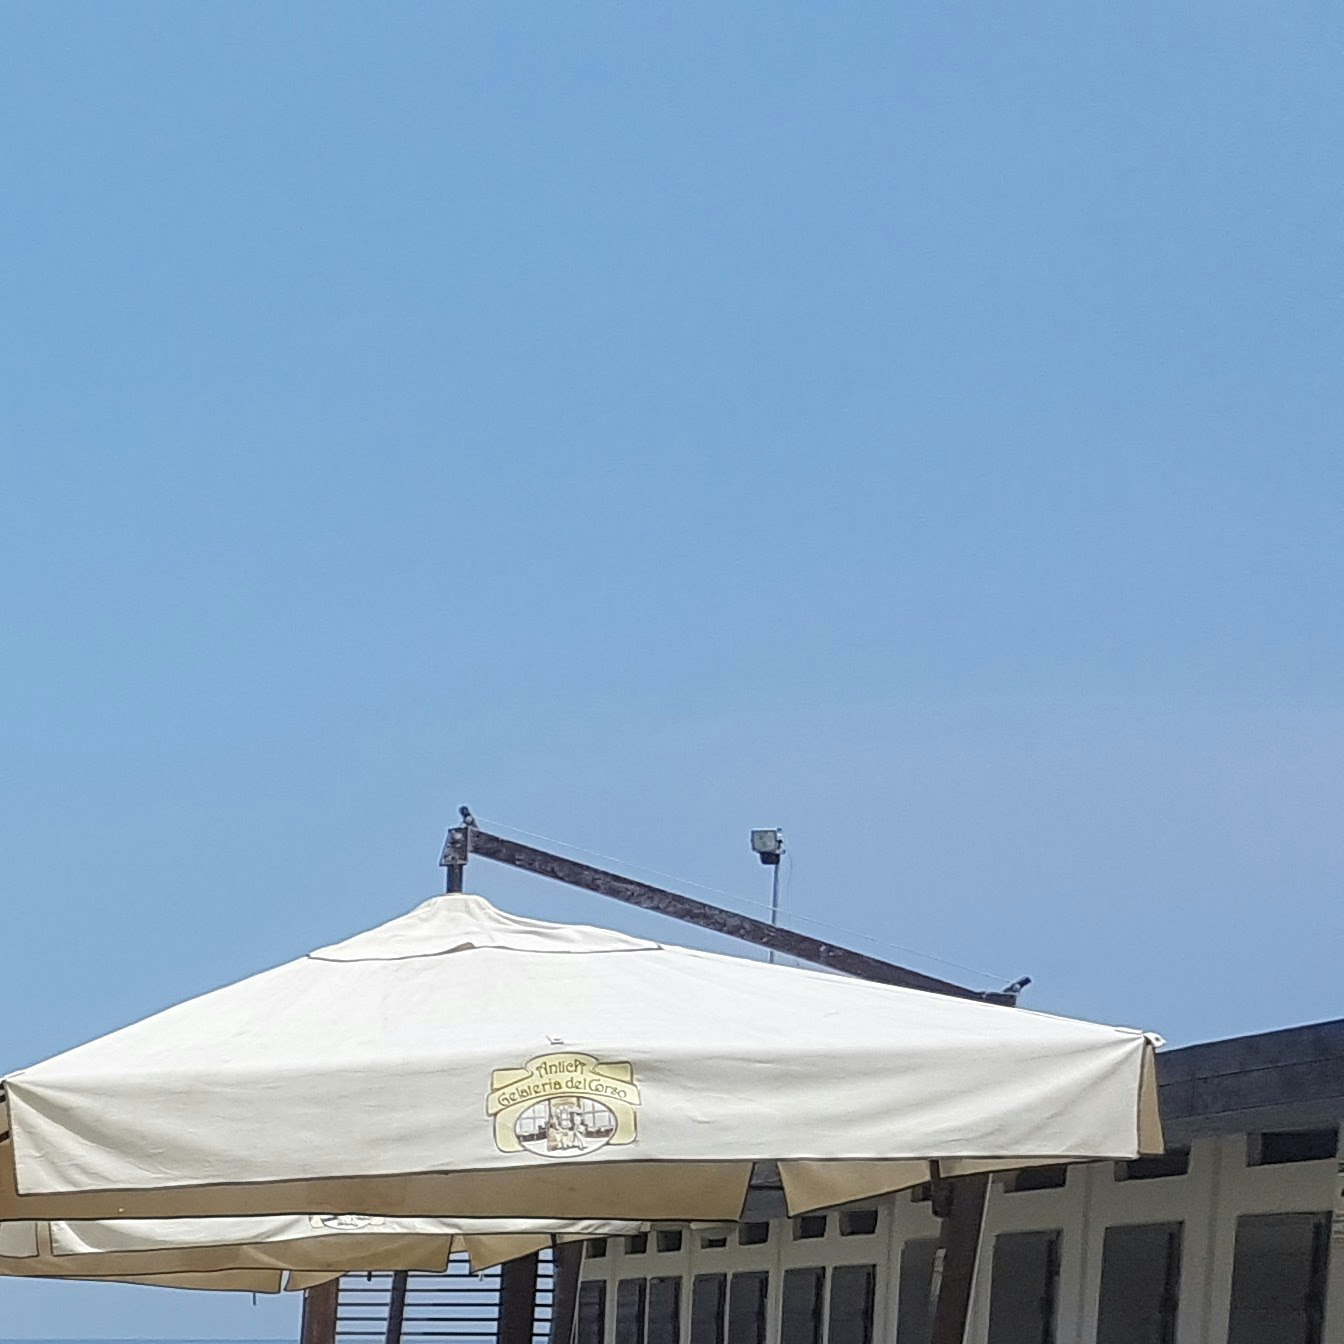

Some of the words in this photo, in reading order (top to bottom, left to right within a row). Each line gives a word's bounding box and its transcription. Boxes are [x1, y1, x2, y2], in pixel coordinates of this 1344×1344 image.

[497, 1078, 562, 1107] Gelateria
[565, 1077, 586, 1090] del
[588, 1078, 627, 1099] Corso
